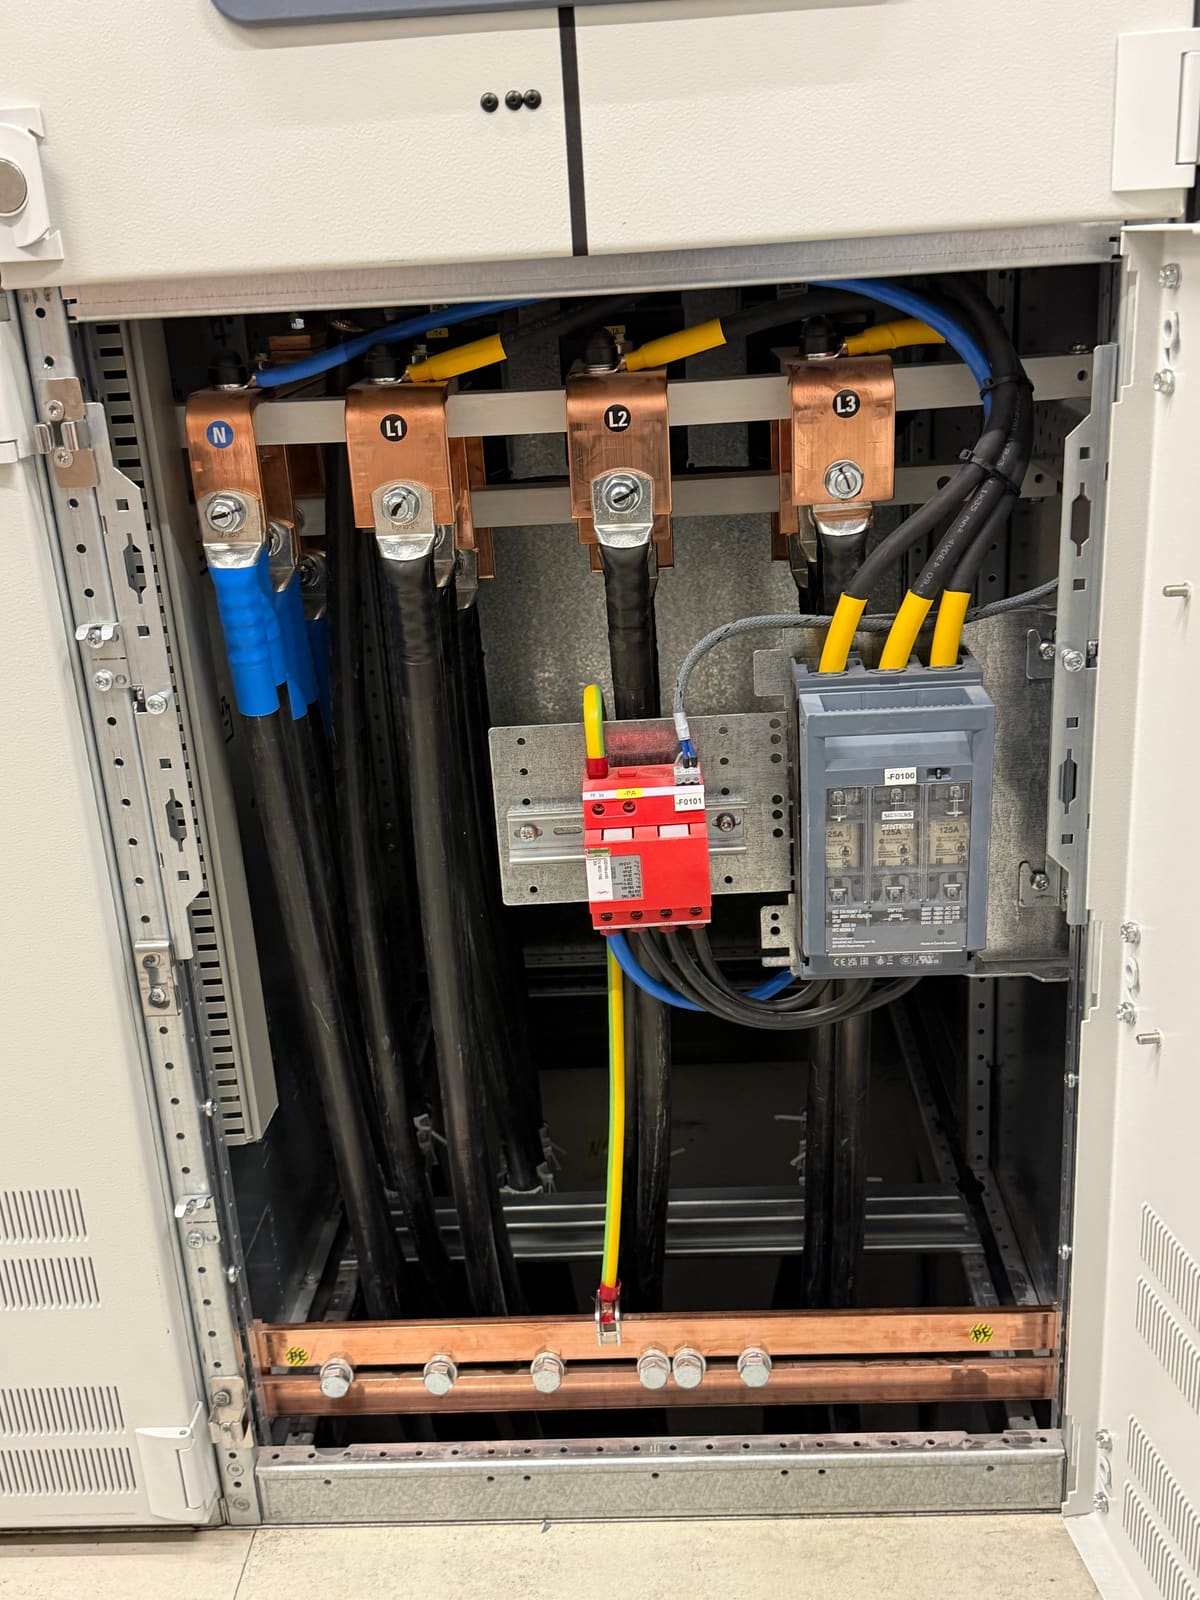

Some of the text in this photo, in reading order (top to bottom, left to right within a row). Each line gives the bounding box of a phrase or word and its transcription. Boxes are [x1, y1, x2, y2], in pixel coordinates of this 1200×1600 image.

[836, 395, 855, 415] L3
[608, 409, 627, 429] L2
[212, 425, 226, 444] N
[386, 417, 404, 438] L1
[886, 771, 915, 782] -F0100
[676, 797, 702, 806] -F0101
[940, 826, 960, 834] 125A
[973, 1326, 992, 1340] PE
[290, 1350, 307, 1362] PE
